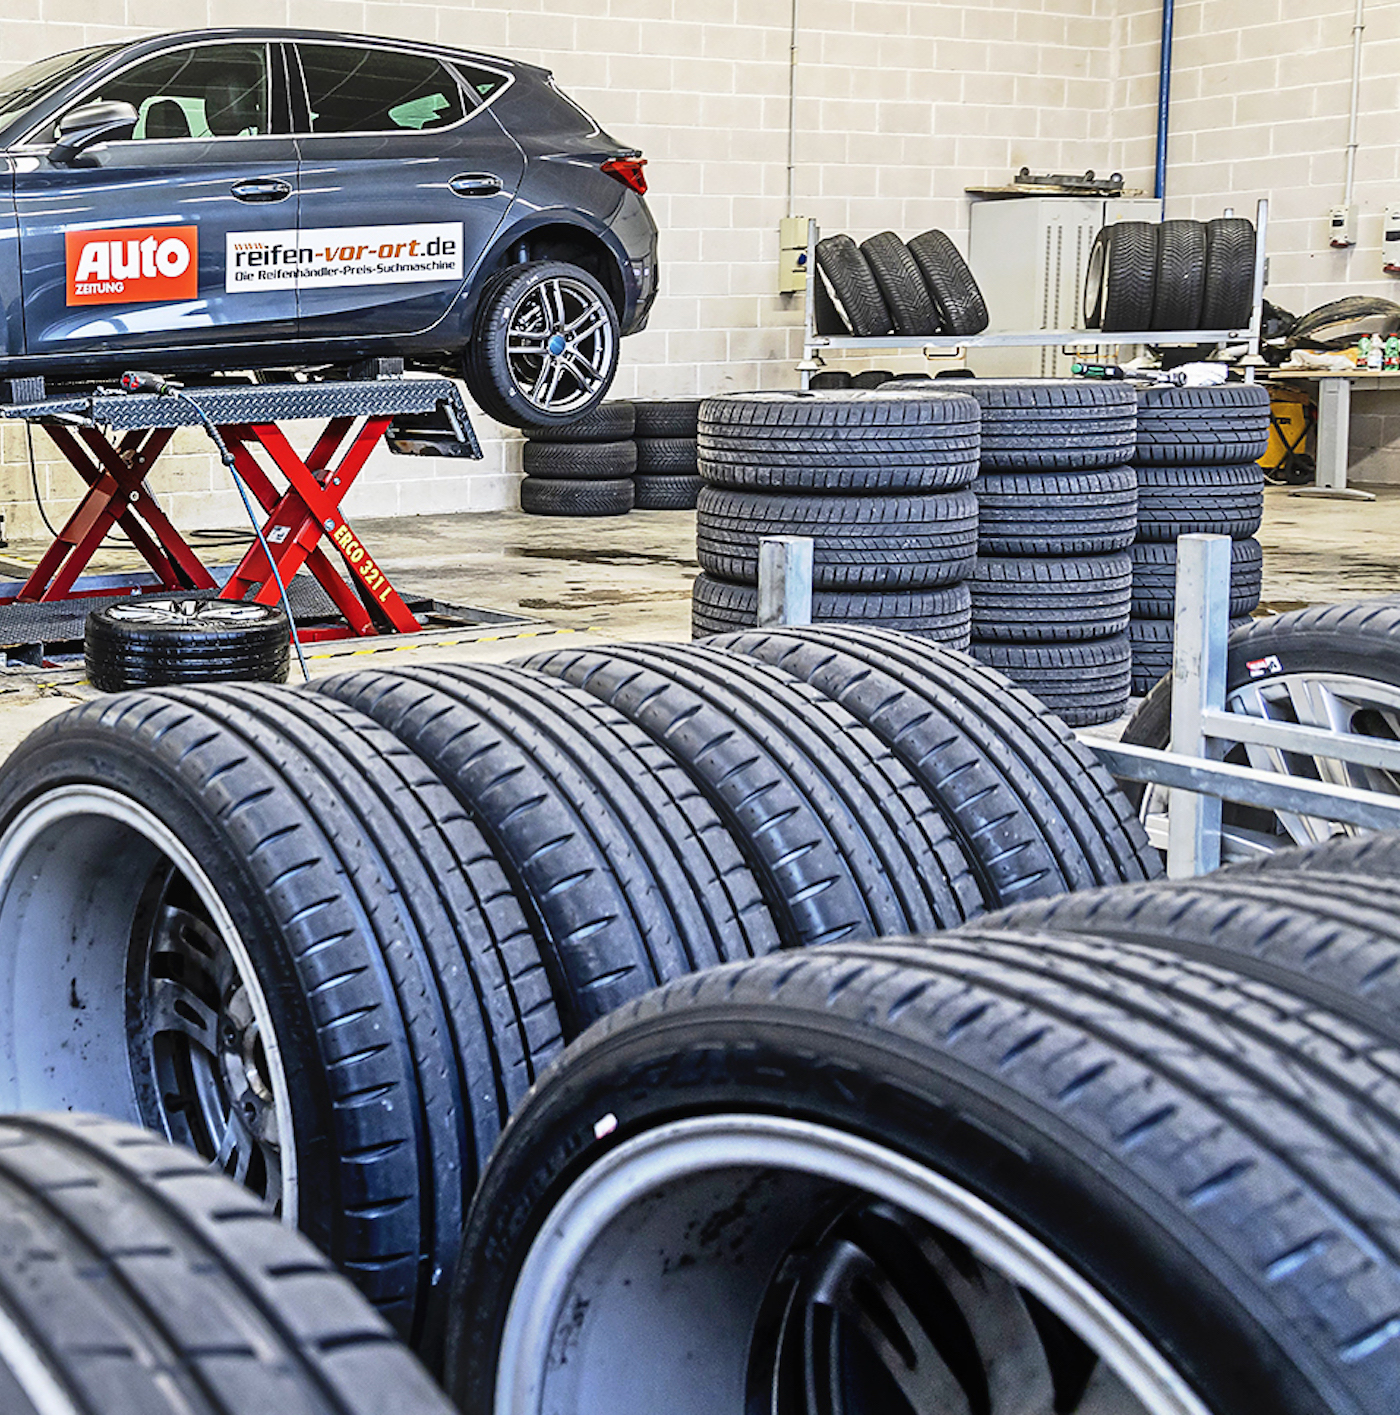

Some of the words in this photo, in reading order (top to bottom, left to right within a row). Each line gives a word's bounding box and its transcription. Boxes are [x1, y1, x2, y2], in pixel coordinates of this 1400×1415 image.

[235, 236, 456, 267] reifen-vor-ort.de
[235, 271, 255, 281] Die
[258, 260, 456, 280] Reifenhändler-Preis-Suchmaschine
[74, 281, 125, 295] ZEITUNG
[334, 525, 364, 562] ERCO
[360, 561, 385, 590] 321
